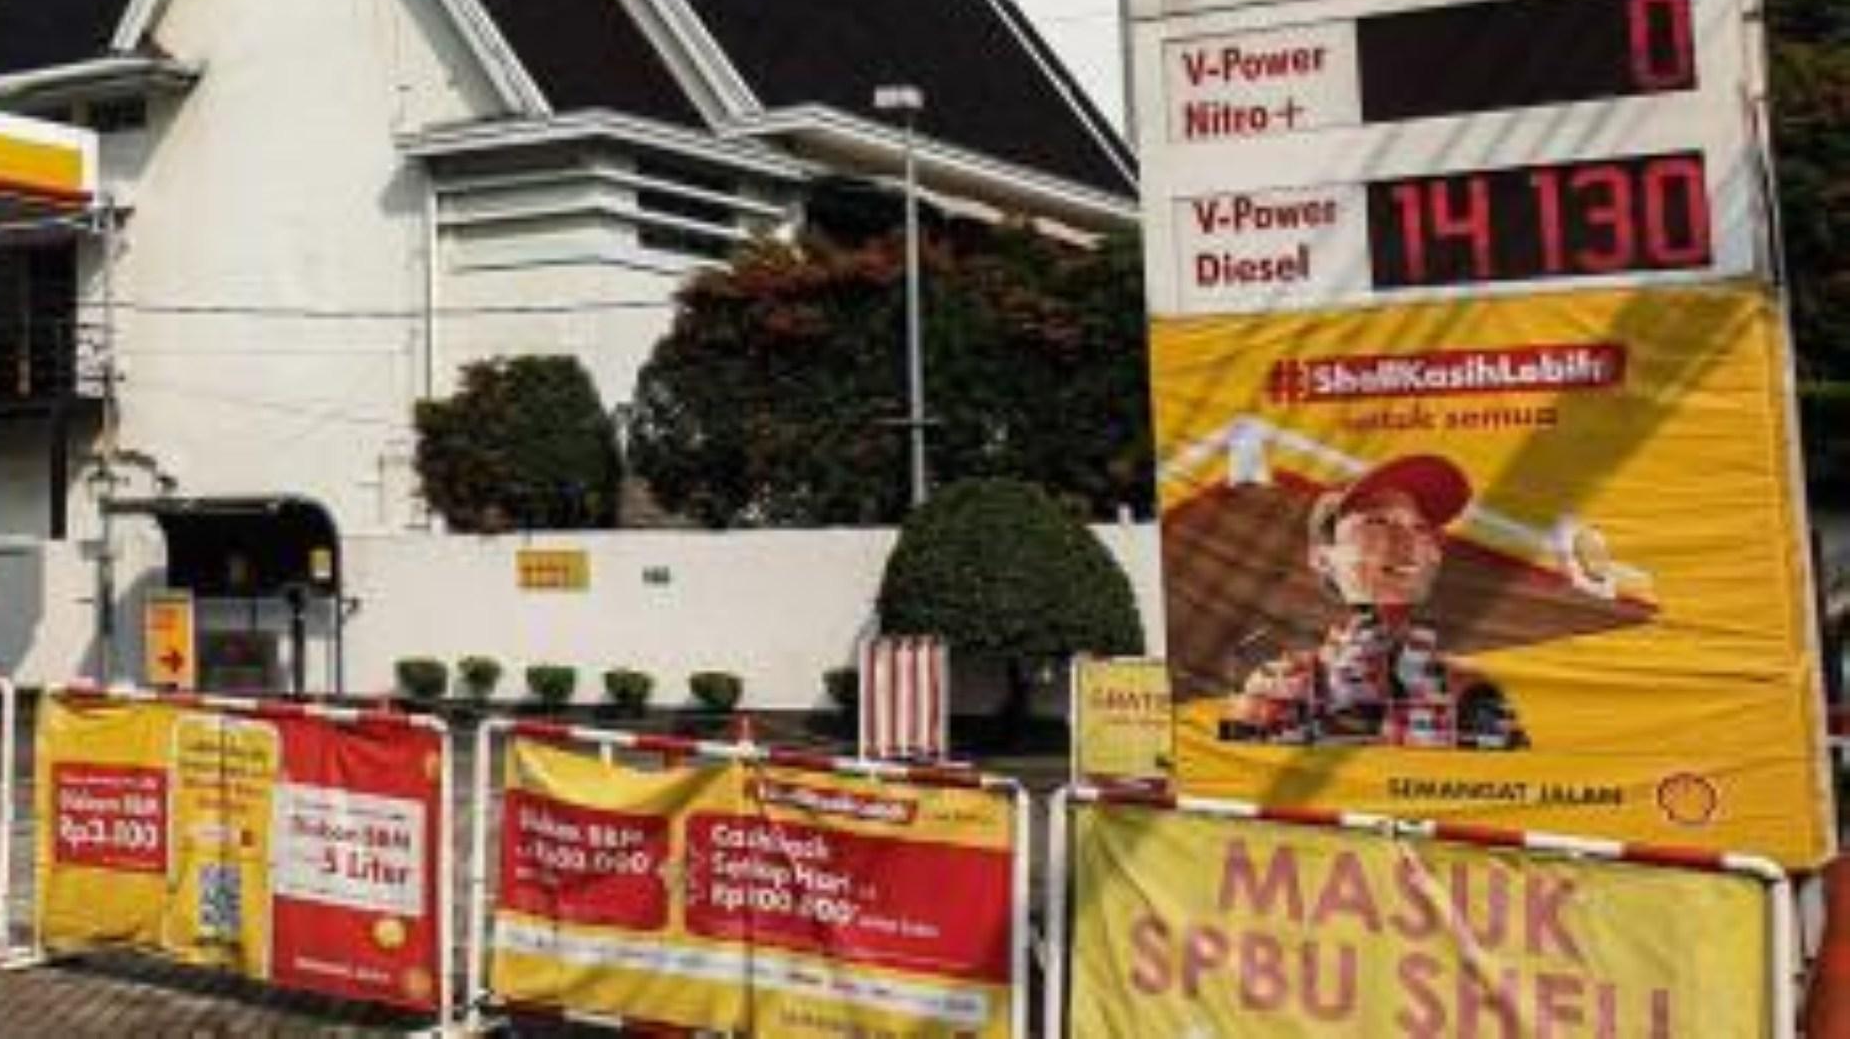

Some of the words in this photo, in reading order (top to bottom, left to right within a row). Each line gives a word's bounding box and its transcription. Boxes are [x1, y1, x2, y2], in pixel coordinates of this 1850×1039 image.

[1182, 42, 1326, 86] V-Power
[1184, 99, 1305, 139] Nitro+
[1194, 195, 1337, 235] V-Power
[1195, 244, 1310, 287] Diesel
[1445, 408, 1558, 430] semua
[1388, 778, 1526, 801] SEMANGAT
[1540, 783, 1622, 806] JALAN
[347, 851, 410, 884] Liter
[794, 861, 850, 891] Hari
[1219, 837, 1580, 956] MASUK
[1129, 915, 1357, 1019] SPBU
